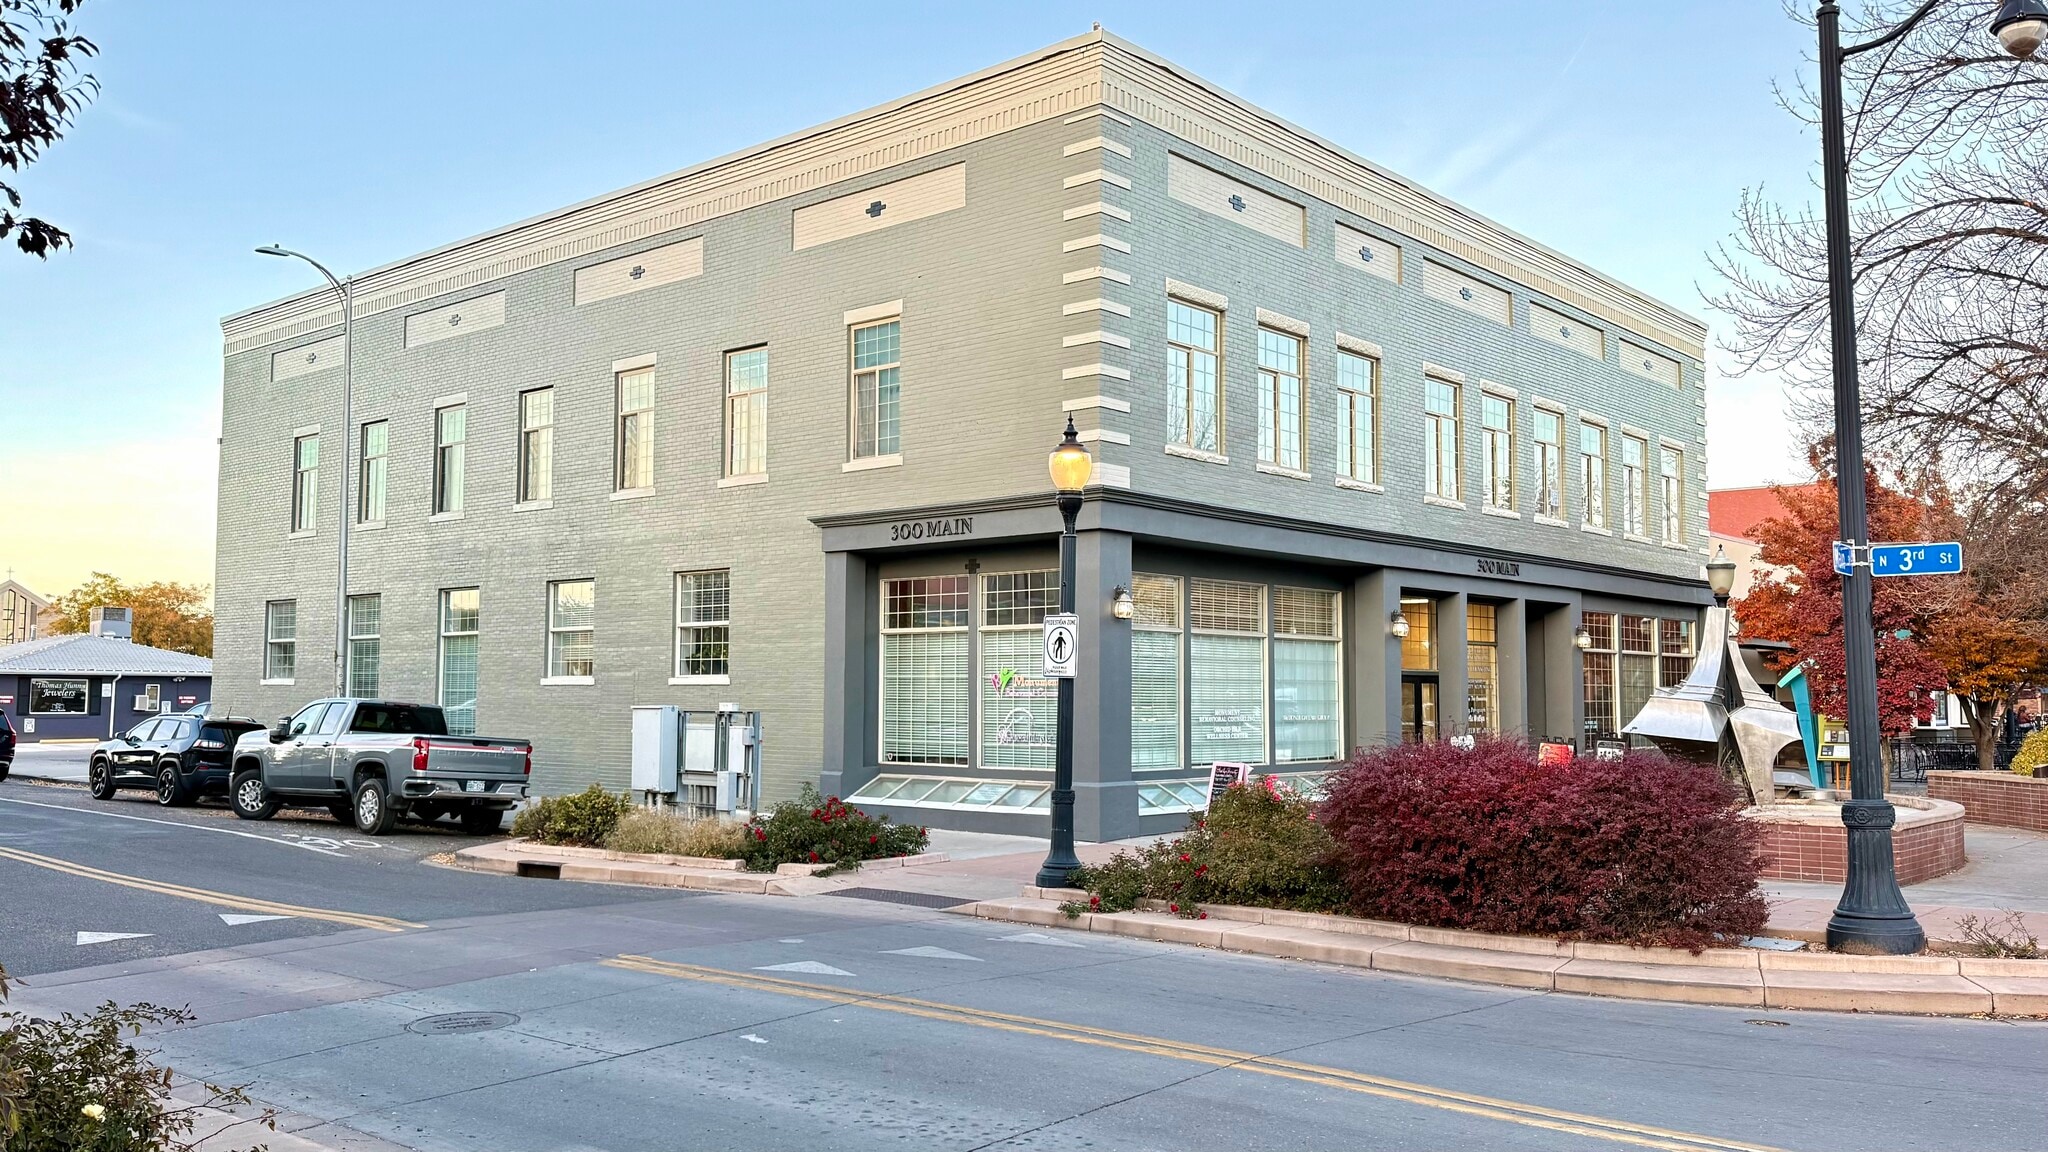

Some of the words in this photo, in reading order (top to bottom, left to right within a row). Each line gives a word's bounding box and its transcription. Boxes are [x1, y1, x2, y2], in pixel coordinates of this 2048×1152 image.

[891, 522, 923, 541] 300
[926, 517, 973, 537] MAIN
[1477, 559, 1496, 574] 300
[1496, 561, 1520, 576] MAIN
[1880, 556, 1887, 567] N
[1899, 549, 1925, 571] 3rd
[1939, 552, 1953, 564] St
[1013, 676, 1058, 688] Monumen
[41, 689, 76, 698] Jewelers
